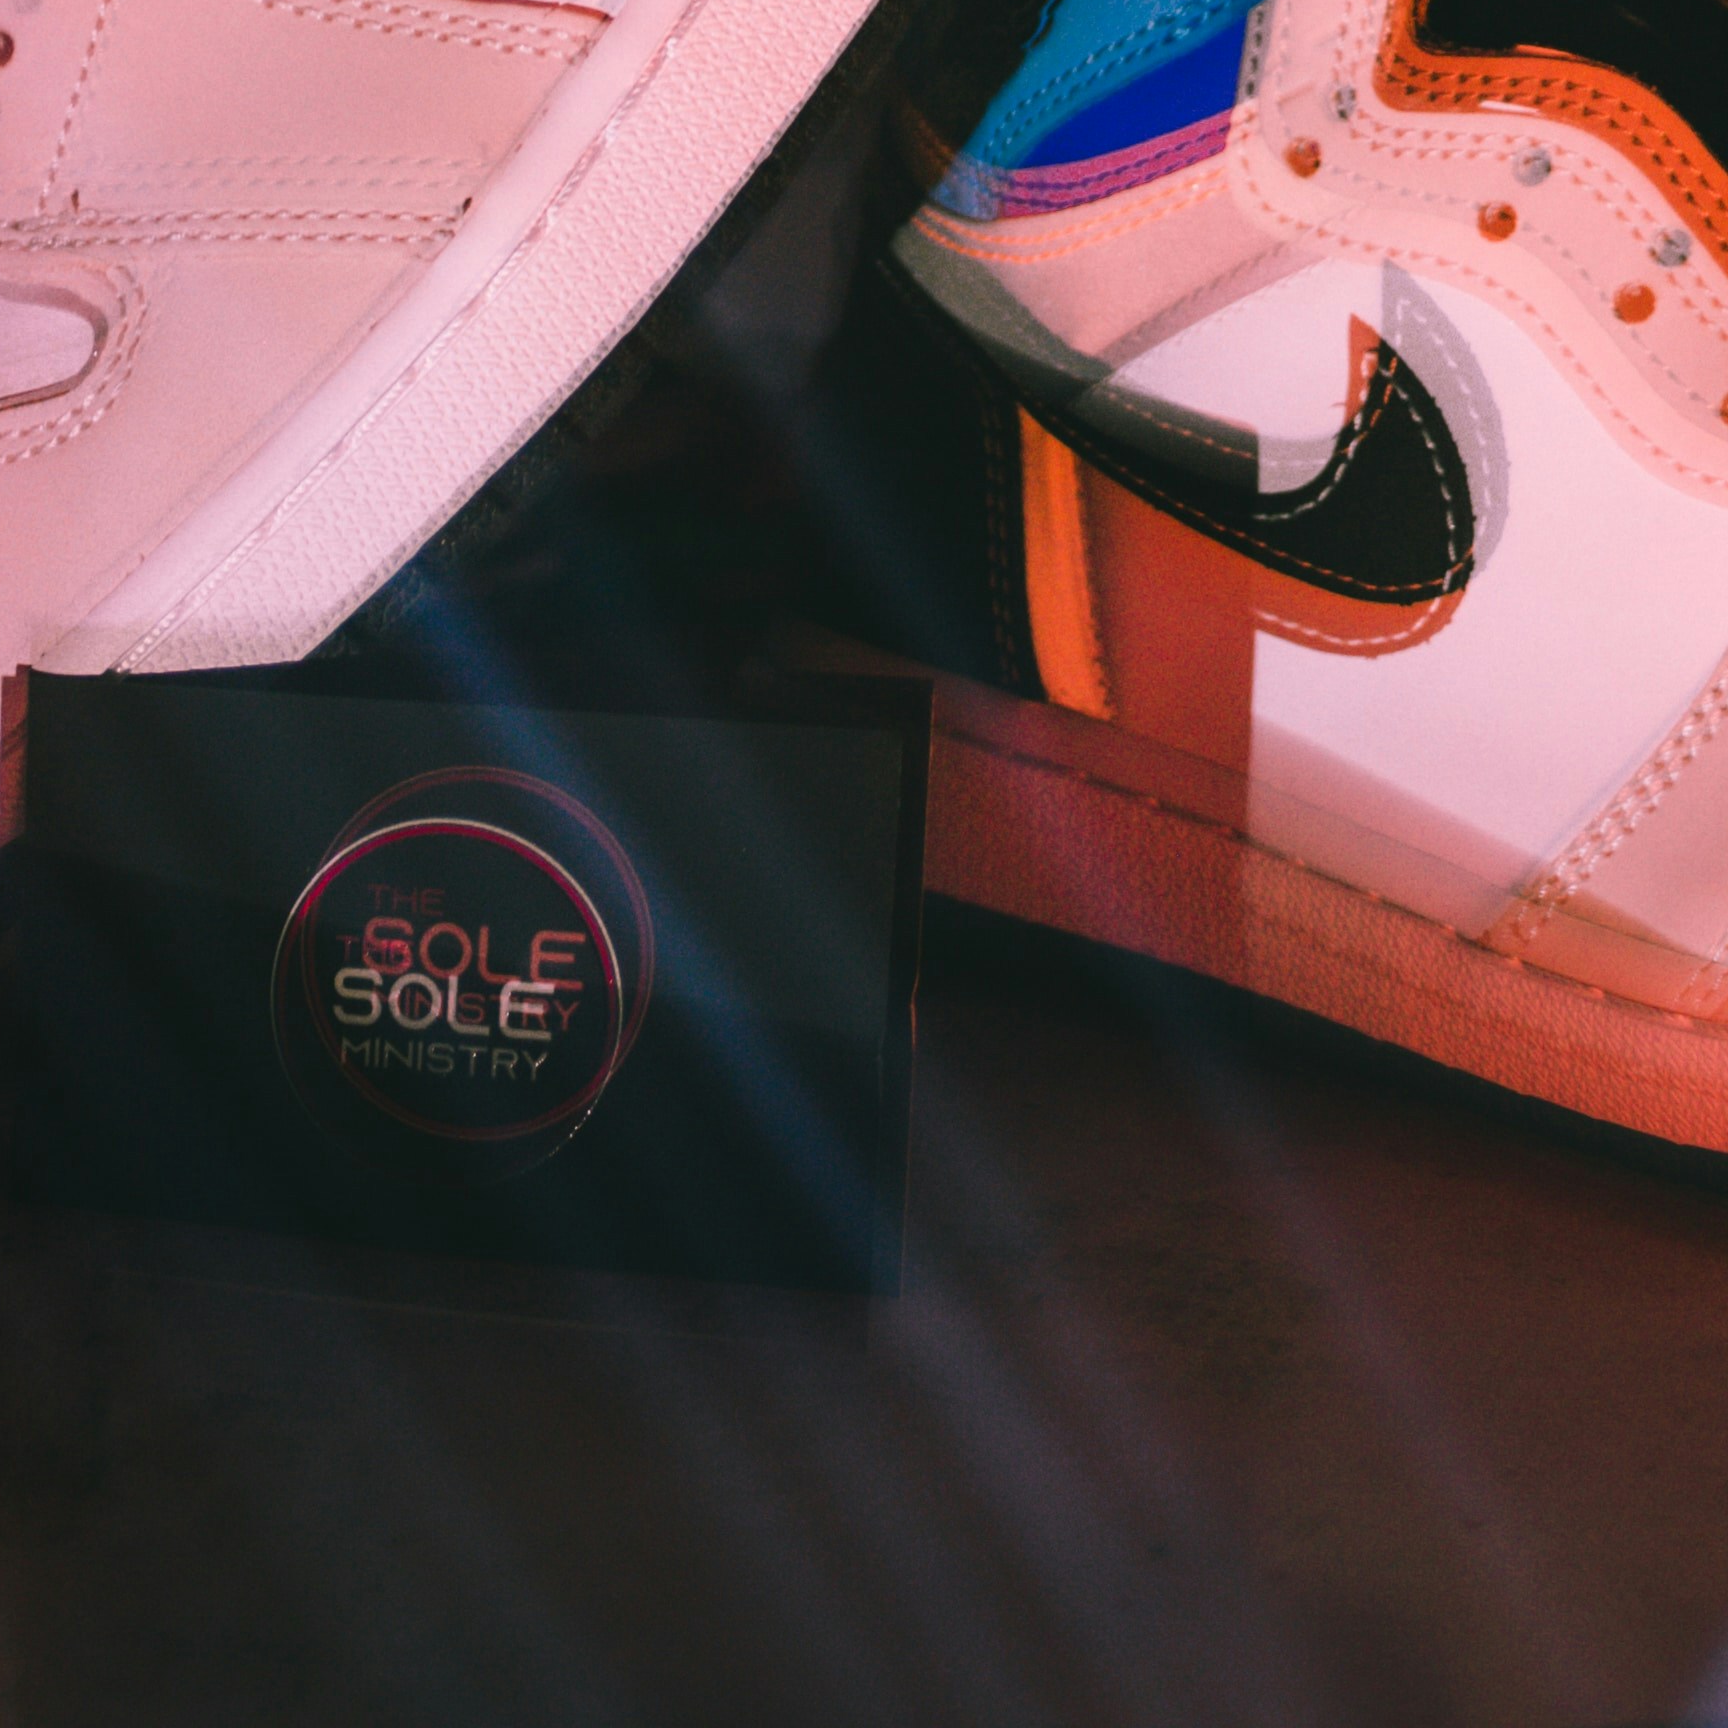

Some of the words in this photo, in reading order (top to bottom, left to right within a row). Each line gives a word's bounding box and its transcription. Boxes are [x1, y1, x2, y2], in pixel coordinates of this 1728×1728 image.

[368, 883, 446, 918] THE
[361, 915, 588, 992] SOLE
[332, 967, 556, 1042] SOLE
[340, 1035, 550, 1080] MINISTRY
